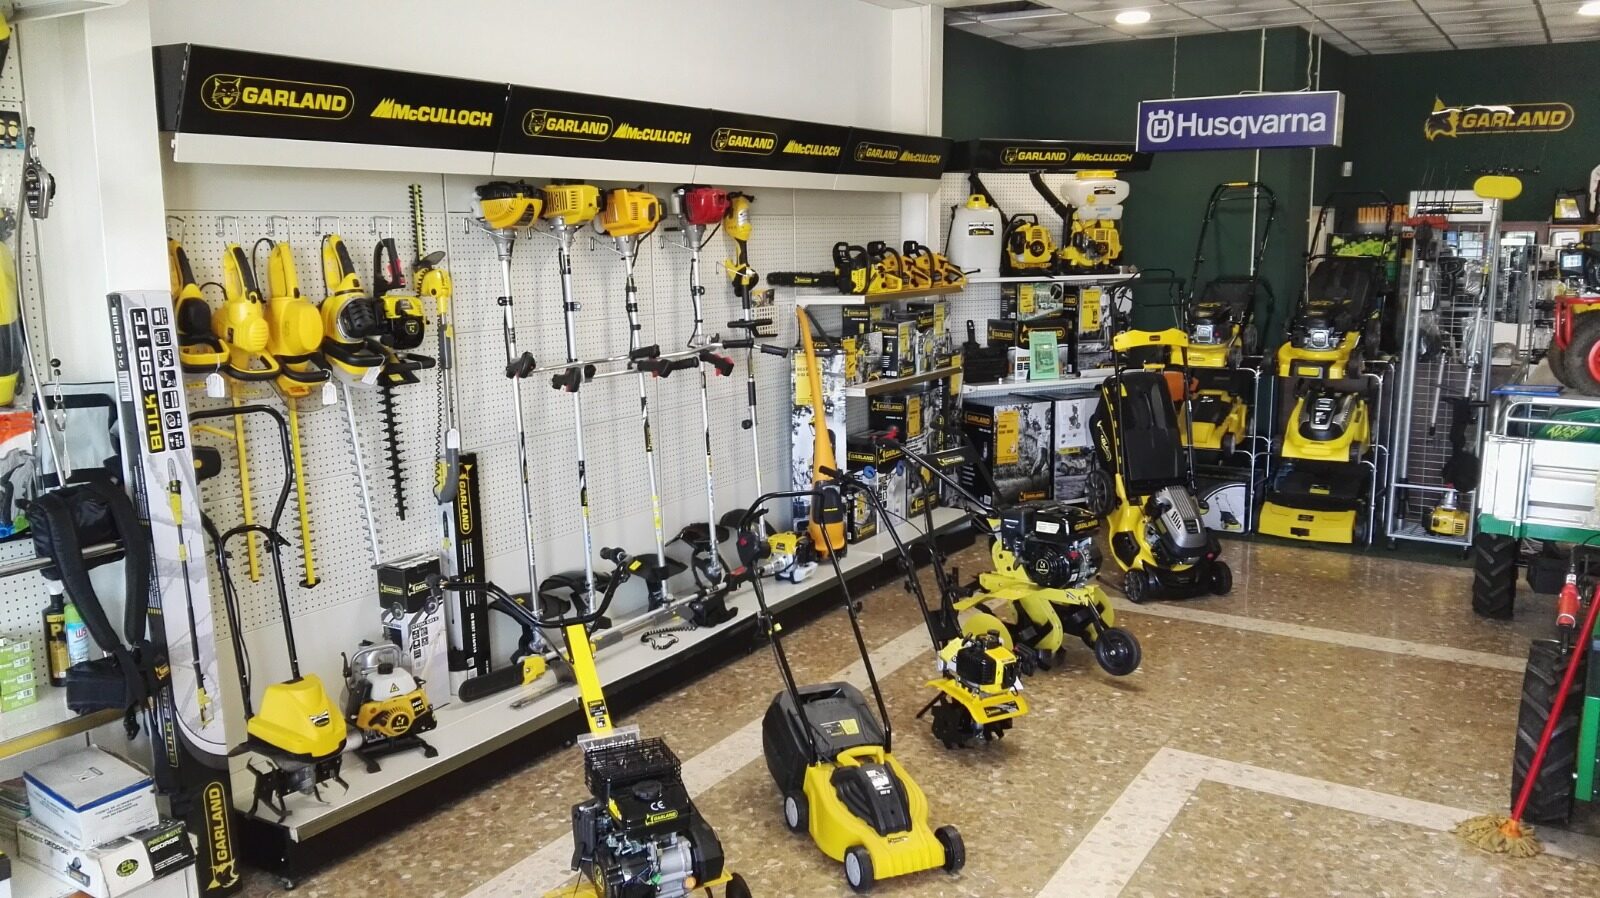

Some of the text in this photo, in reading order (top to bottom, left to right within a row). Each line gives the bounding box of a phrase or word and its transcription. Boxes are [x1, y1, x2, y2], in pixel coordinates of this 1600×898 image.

[241, 87, 494, 127] GARLAND McCULLOCH
[1177, 108, 1327, 142] Husqvarna
[1461, 108, 1567, 128] GARLAND
[545, 116, 691, 145] GARLAND McCULLOCH
[728, 134, 775, 151] GARLAND
[865, 147, 899, 160] GARLAND
[1018, 150, 1067, 163] GARLAND
[133, 312, 163, 450] BULK 298 FE
[850, 453, 874, 461] GARLAND
[885, 448, 901, 458] GARLA
[459, 480, 470, 531] GARLAND
[213, 786, 230, 861] GARLAND
[653, 811, 677, 820] GARLAND
